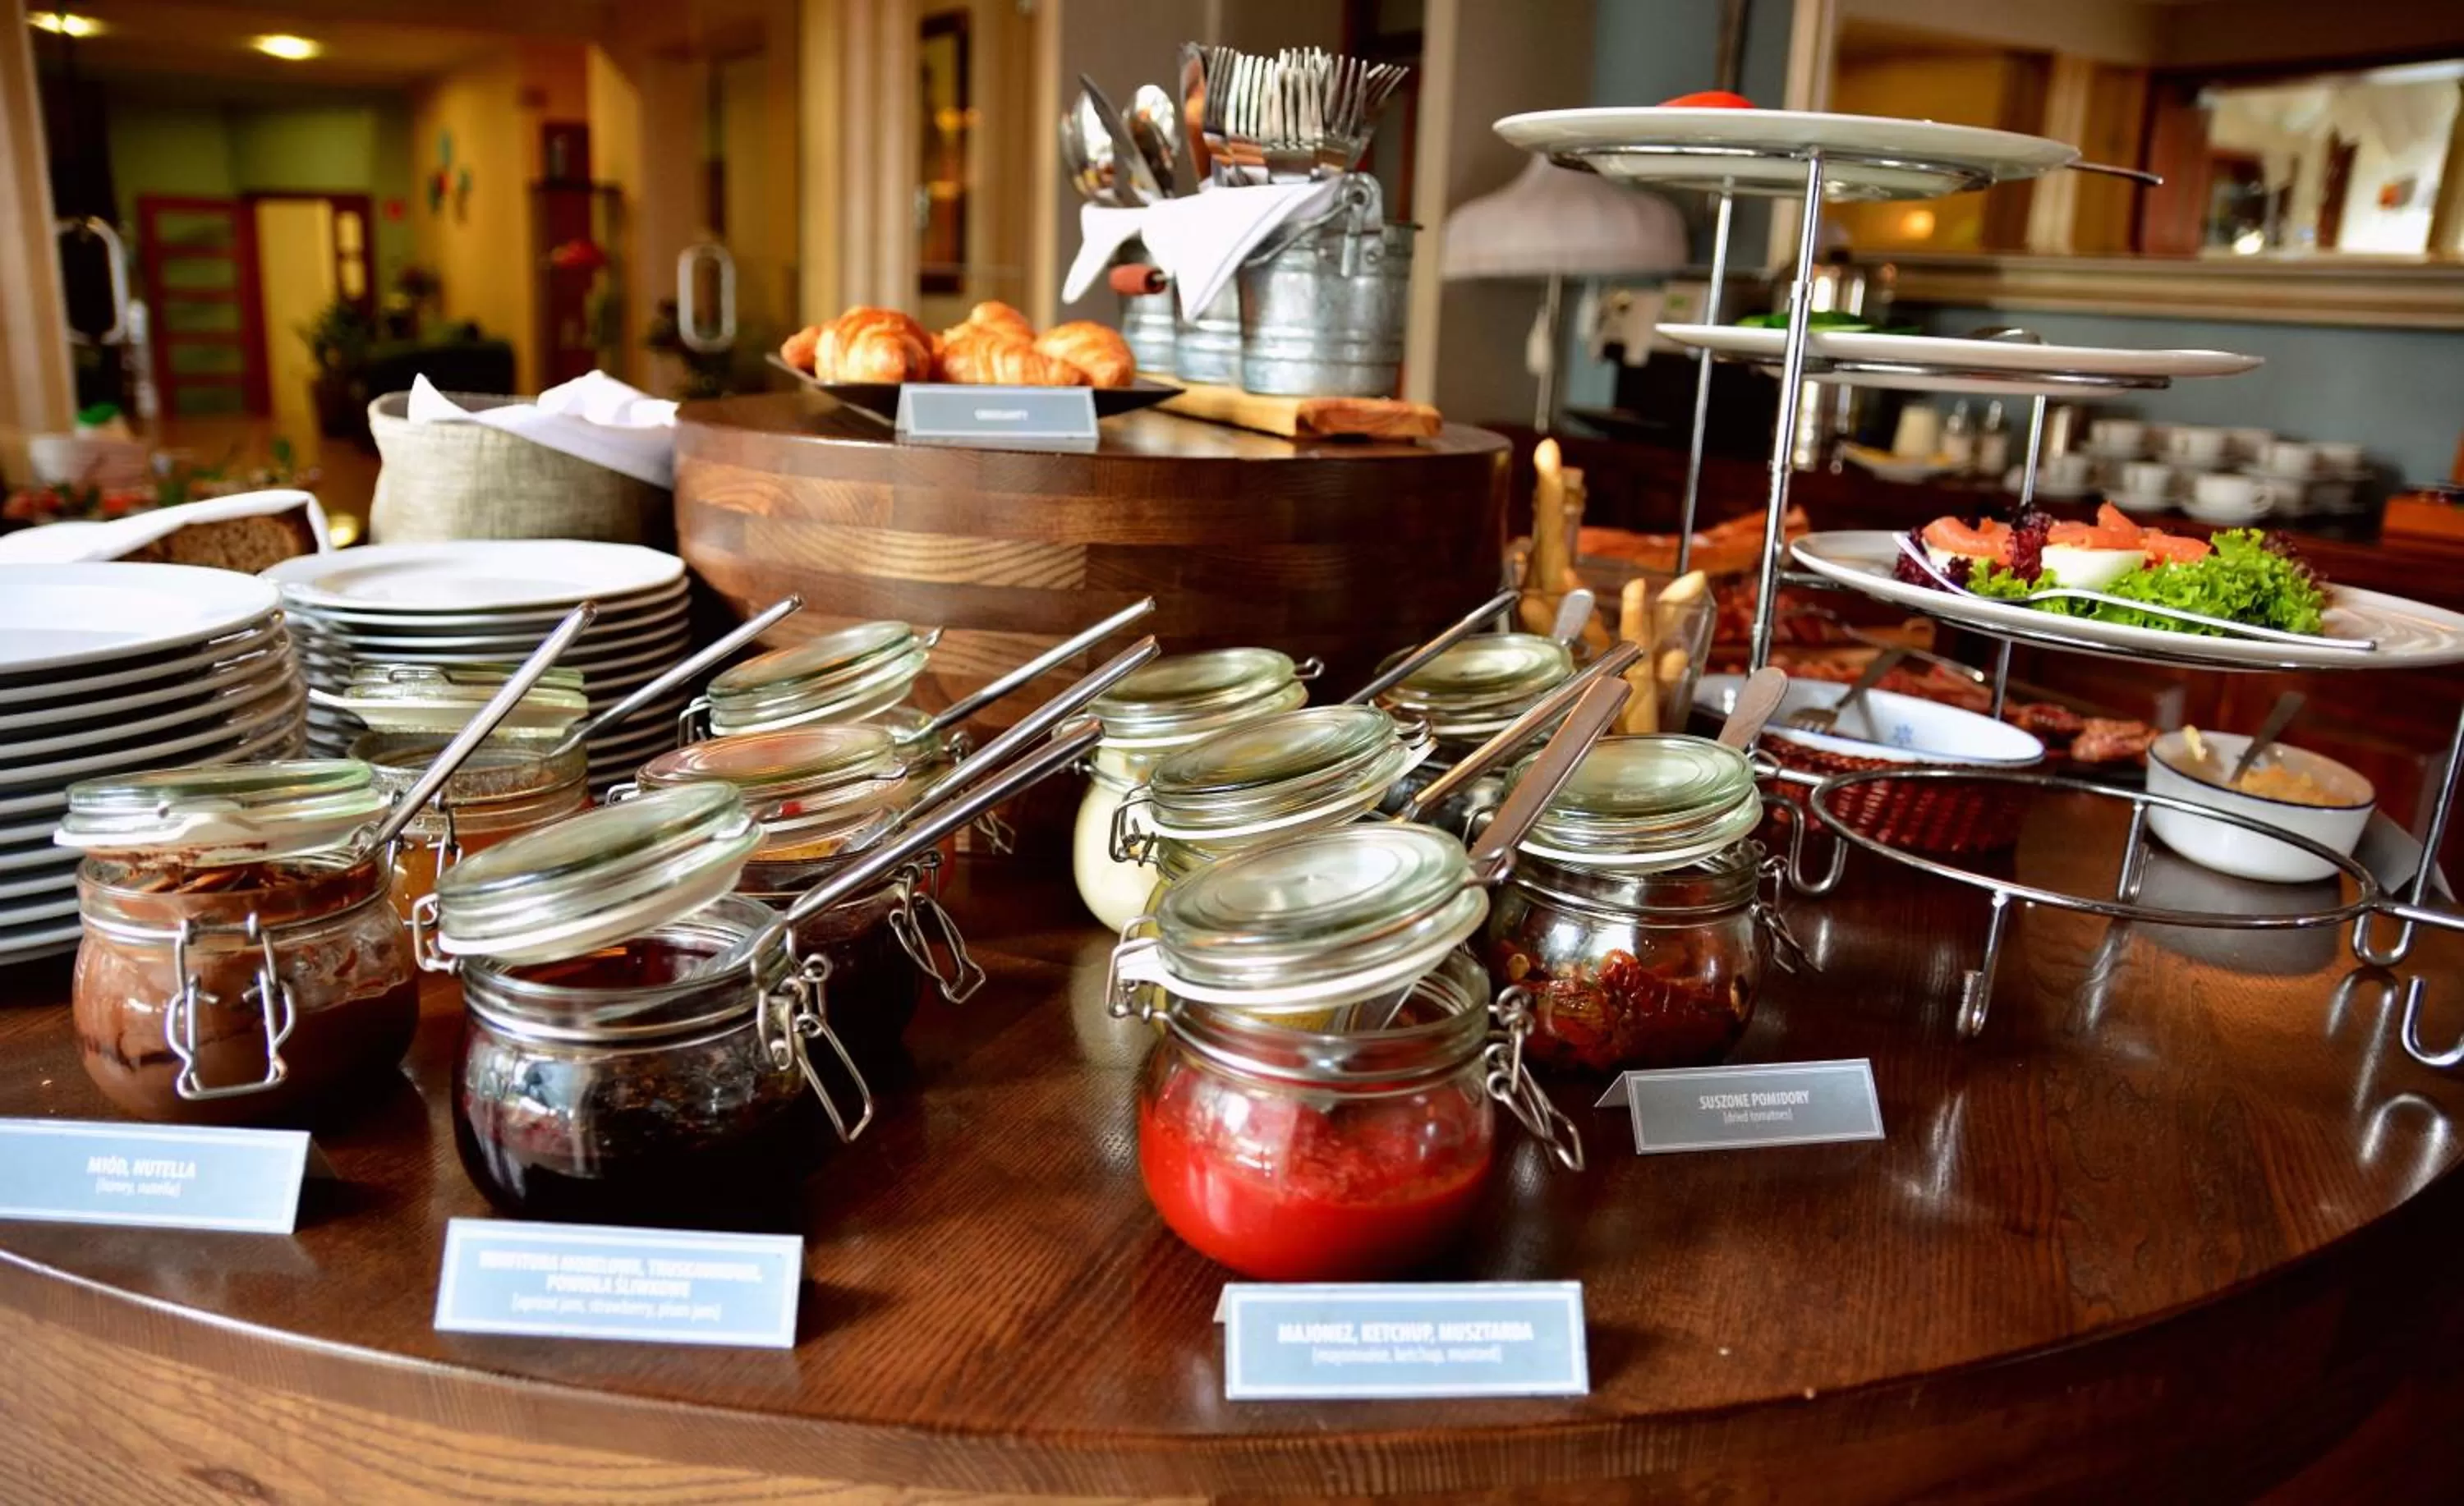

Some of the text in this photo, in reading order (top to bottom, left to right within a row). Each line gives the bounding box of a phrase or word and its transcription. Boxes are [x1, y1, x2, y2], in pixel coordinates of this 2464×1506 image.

[1699, 1090, 1809, 1110] SUSZONE POMIDORY
[132, 1159, 196, 1180] NUTELLA
[1277, 1320, 1534, 1344] MAJONEZ, KETCHUP, MUSZTARDA
